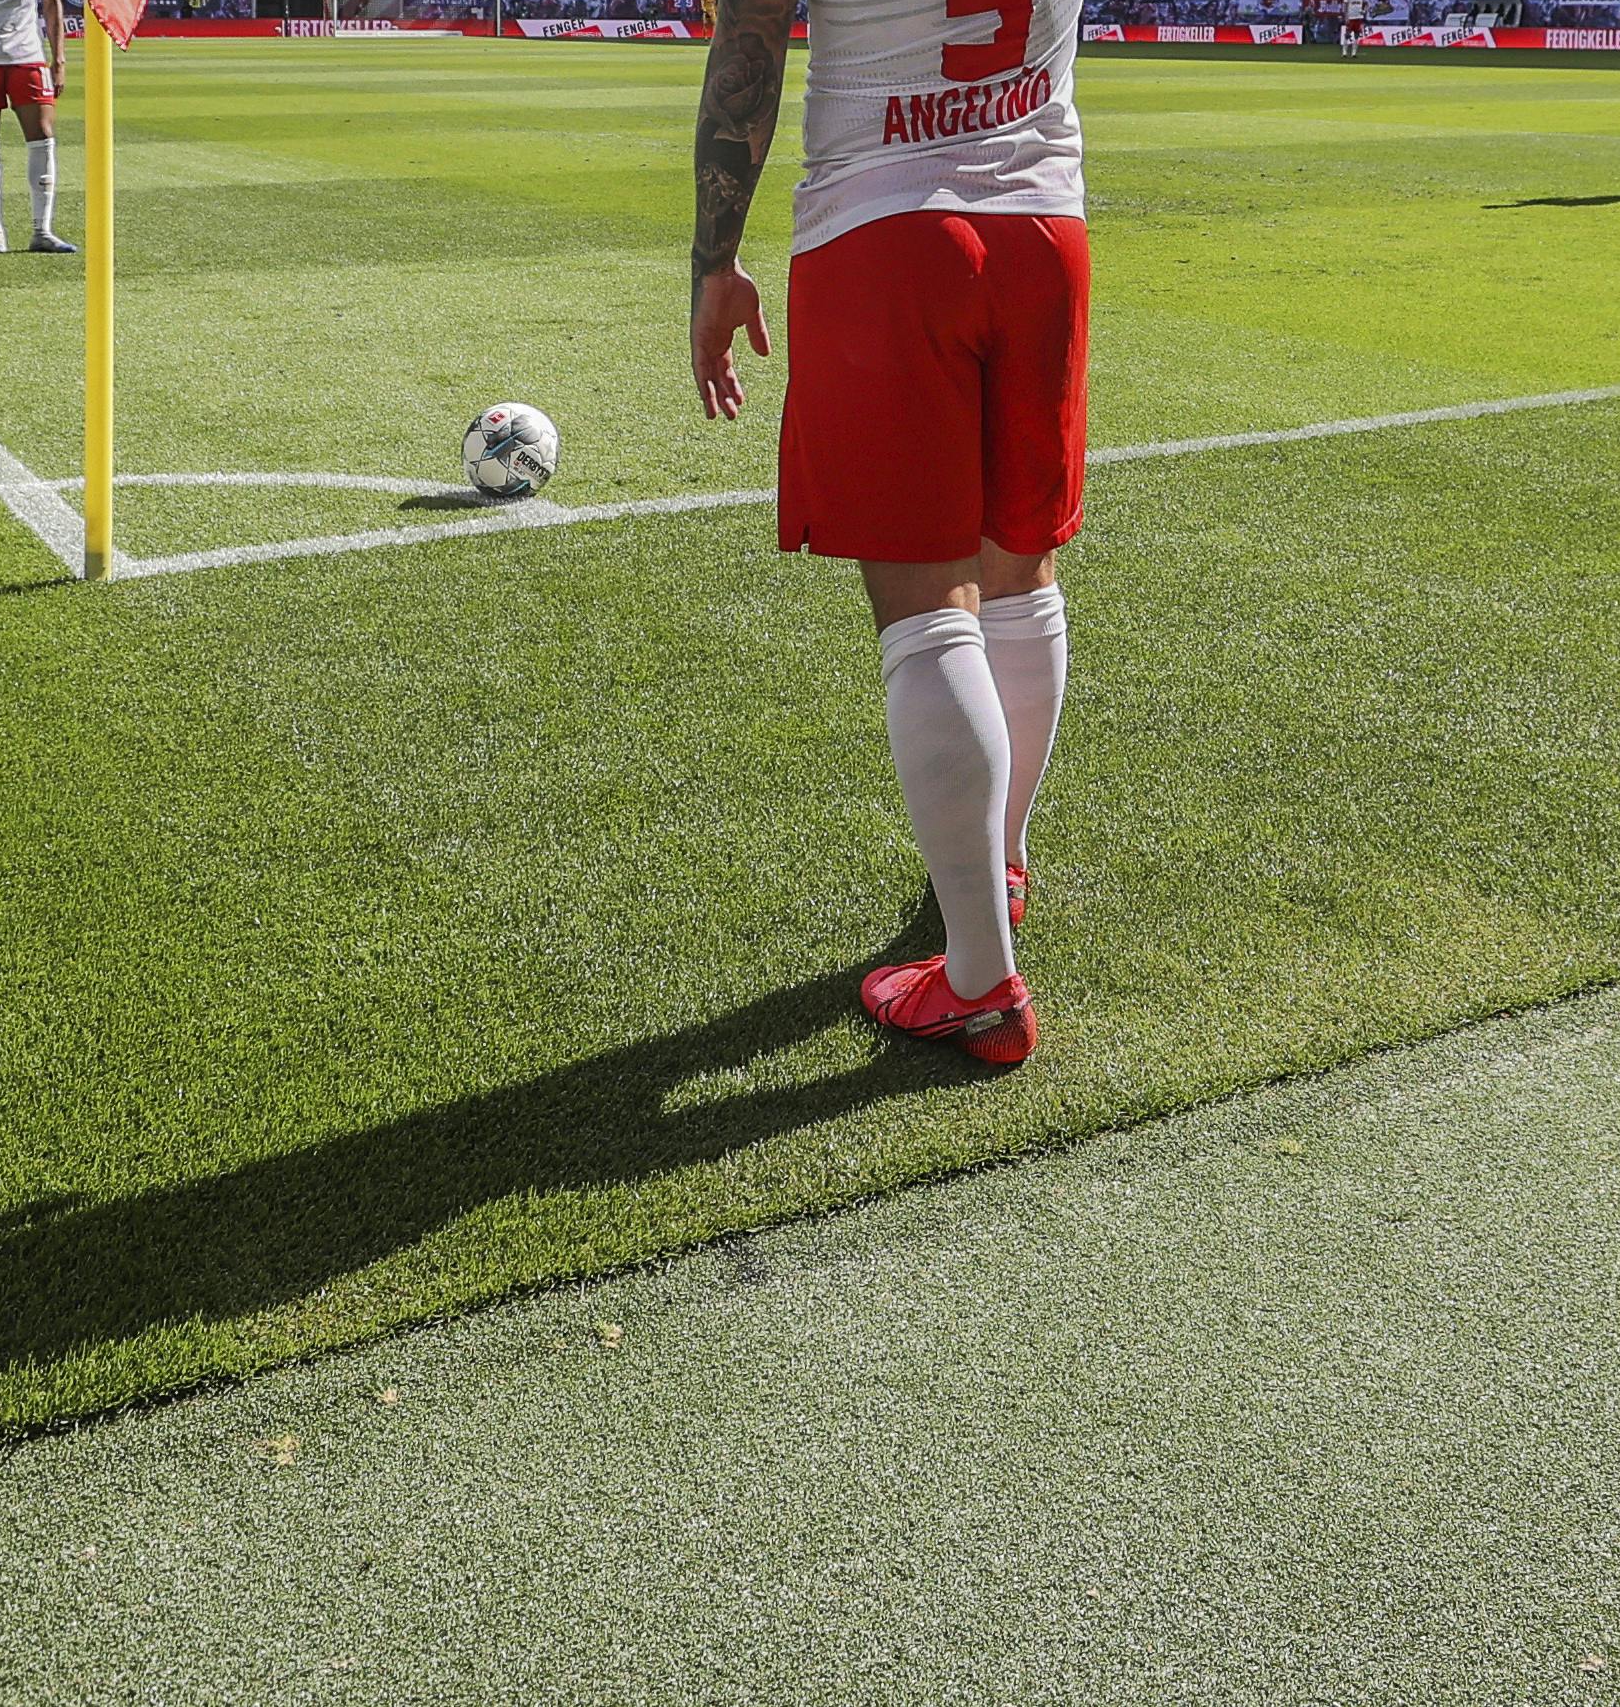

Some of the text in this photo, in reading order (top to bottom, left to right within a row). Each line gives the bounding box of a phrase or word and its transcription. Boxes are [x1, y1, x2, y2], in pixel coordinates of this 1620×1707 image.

[543, 19, 586, 37] FENGER
[617, 20, 659, 37] FENGER
[1088, 26, 1110, 39] FENGER
[1158, 26, 1215, 42] FERTIGKELLER
[1259, 25, 1286, 42] FENGER
[1391, 25, 1423, 44] FENGER
[1441, 26, 1474, 45] FENGER
[883, 66, 1051, 145] ANGELIÑO
